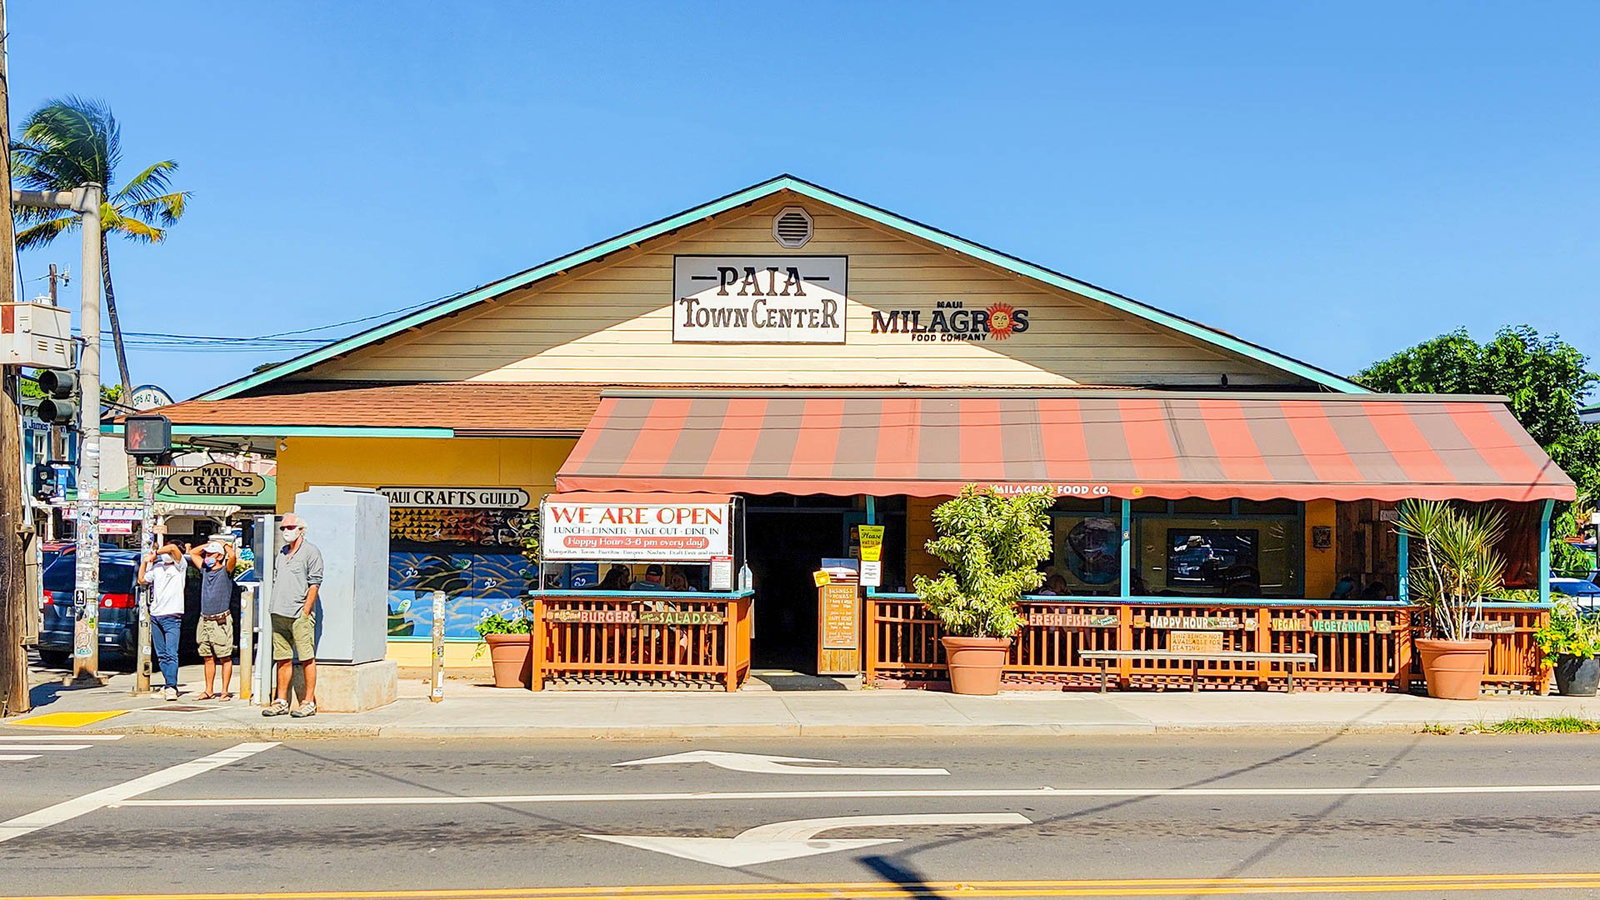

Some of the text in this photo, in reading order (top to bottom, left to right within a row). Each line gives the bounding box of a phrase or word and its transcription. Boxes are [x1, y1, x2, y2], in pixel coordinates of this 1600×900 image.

[717, 267, 807, 296] PAIA
[937, 301, 963, 309] MAUI
[871, 309, 1029, 336] MILAGROS
[912, 333, 987, 342] FOOD COMPANY
[201, 467, 232, 477] MAUI
[179, 476, 254, 487] CRAFTS
[196, 486, 238, 495] GUILD
[1058, 485, 1089, 494] FOOD
[1093, 485, 1111, 495] CO.
[413, 490, 476, 505] CRAFTS
[479, 491, 520, 505] GUILD
[551, 506, 723, 525] WE ARE OPEN
[553, 526, 720, 536] LUNCH DINNER TAKE OUT DINE IN
[861, 531, 881, 540] Please
[567, 537, 598, 548] Happy
[644, 540, 658, 548] pm
[660, 540, 684, 549] every
[686, 538, 705, 549] day!
[581, 611, 636, 623] BURGERS
[660, 612, 708, 624] SALADS
[1030, 614, 1062, 626] FRESH
[1066, 614, 1089, 627] FISH
[1150, 616, 1181, 629] HAPPY
[1183, 617, 1208, 629] HOUR
[1272, 618, 1300, 631] VEGAN
[1312, 620, 1370, 633] VEGETARIAN
